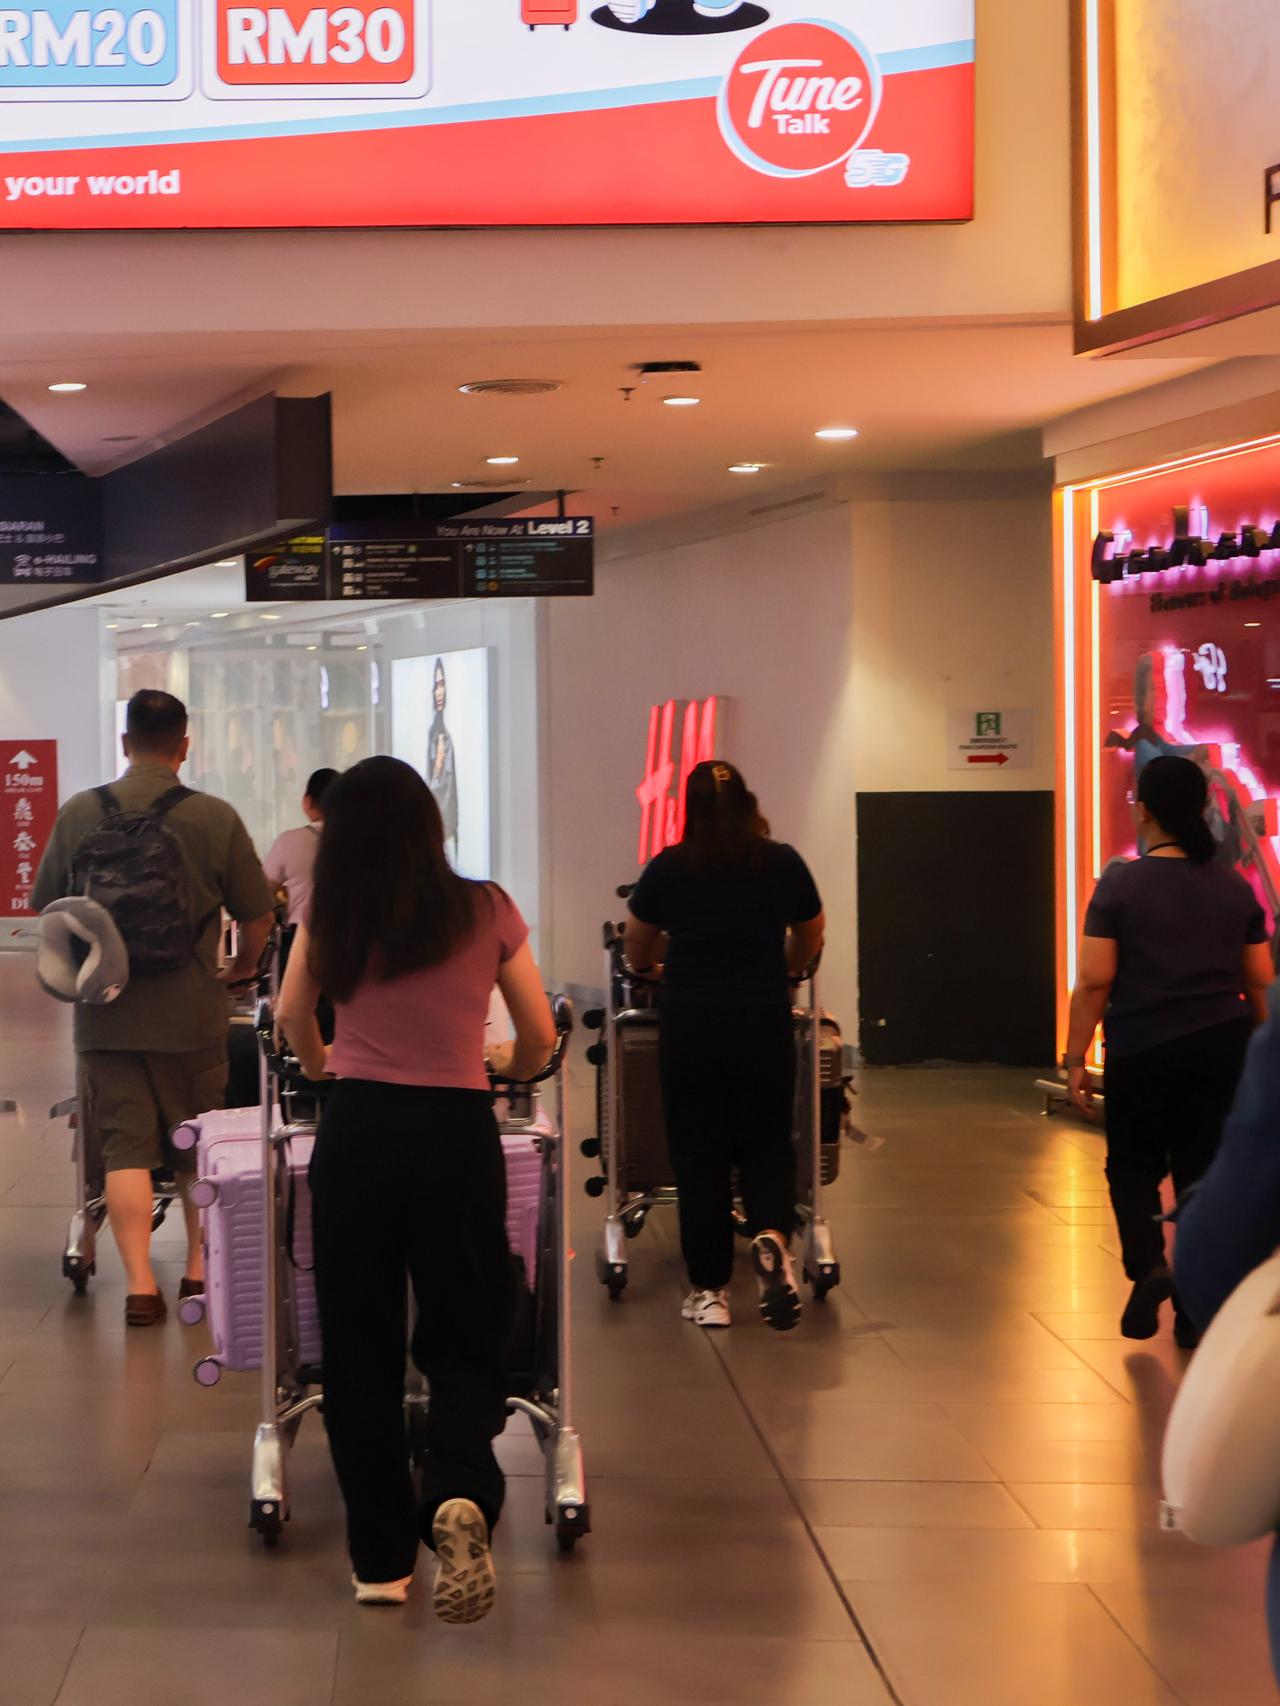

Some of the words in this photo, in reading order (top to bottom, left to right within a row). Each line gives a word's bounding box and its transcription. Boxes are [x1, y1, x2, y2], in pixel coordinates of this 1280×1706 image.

[226, 7, 405, 66] RM30
[739, 58, 863, 129] Tune
[772, 112, 831, 135] Talk
[5, 174, 80, 201] your
[87, 168, 181, 195] world
[844, 148, 911, 188] 5G
[436, 525, 460, 537] You
[460, 525, 480, 536] Are
[482, 525, 509, 536] Now
[528, 519, 573, 535] Level
[576, 520, 590, 534] 2
